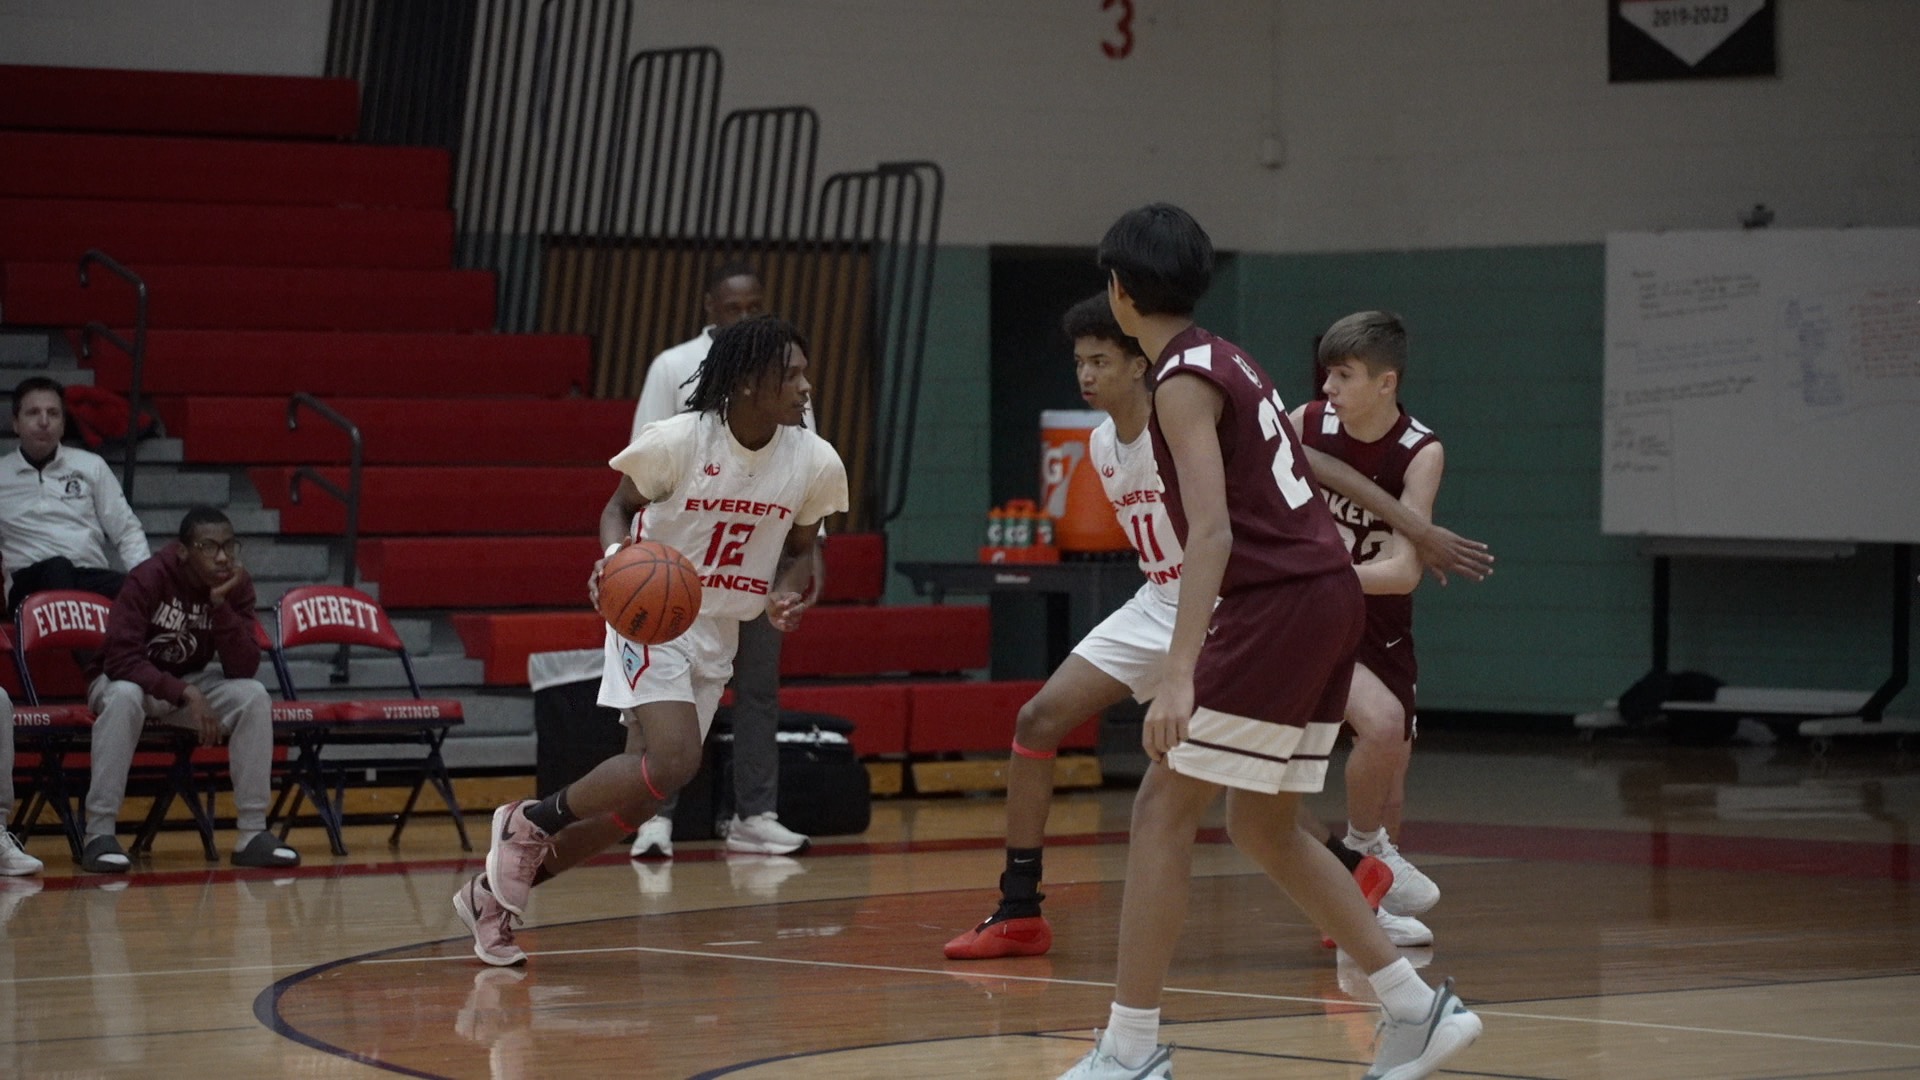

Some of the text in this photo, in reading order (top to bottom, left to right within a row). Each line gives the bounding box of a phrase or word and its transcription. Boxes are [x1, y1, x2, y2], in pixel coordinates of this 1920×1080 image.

[1102, 0, 1133, 58] 3
[1258, 388, 1314, 510] 2
[685, 498, 791, 520] EVERETT
[703, 521, 755, 568] 12
[1131, 513, 1165, 563] 11
[32, 600, 110, 638] EVERET
[292, 595, 379, 633] EVERETT
[272, 708, 314, 722] KINGS
[383, 705, 440, 720] VIKINGS
